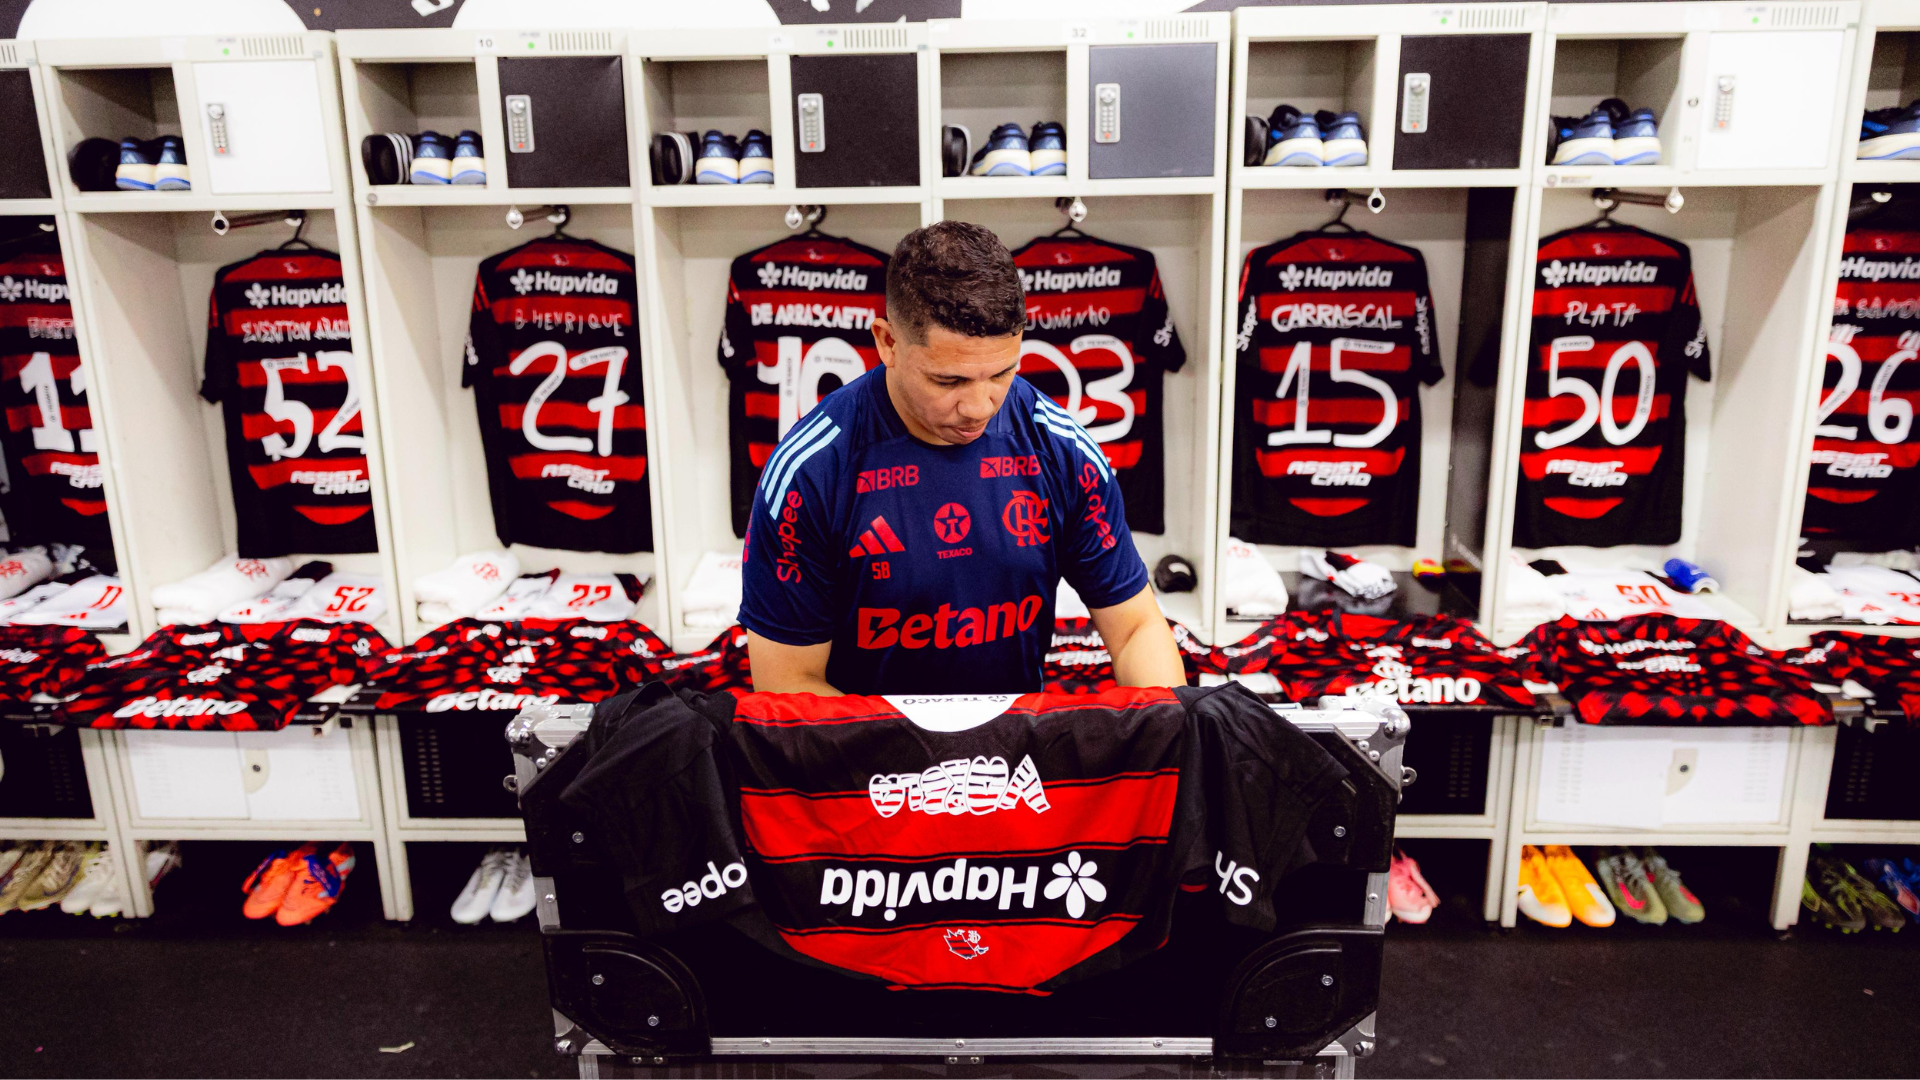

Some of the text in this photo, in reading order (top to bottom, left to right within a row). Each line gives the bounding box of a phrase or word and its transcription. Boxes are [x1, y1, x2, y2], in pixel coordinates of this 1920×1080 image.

[479, 38, 493, 48] 10
[534, 270, 619, 295] Hapvida
[781, 266, 868, 291] Hapvida
[1034, 265, 1122, 293] Hapvida
[1303, 264, 1394, 289] Hapvida
[1566, 260, 1658, 286] Hapvida
[1842, 256, 1920, 282] Hapvid
[532, 309, 625, 337] HENRIQUE
[1271, 303, 1403, 332] CARRASCAL
[1565, 300, 1642, 327] PLATA
[261, 350, 367, 461] 52
[509, 340, 630, 458] 27
[1267, 336, 1398, 449] 15
[1534, 335, 1656, 450] 50
[1815, 342, 1917, 445] 26
[876, 465, 920, 488] BRB
[1001, 455, 1041, 477] BRB
[776, 490, 803, 584] Shopee
[936, 547, 973, 560] TEXACO
[326, 586, 374, 612] 52
[857, 595, 1043, 650] Betano
[902, 695, 982, 706] TEXACO
[661, 861, 748, 913] opee
[820, 857, 1039, 922] Hapvida
